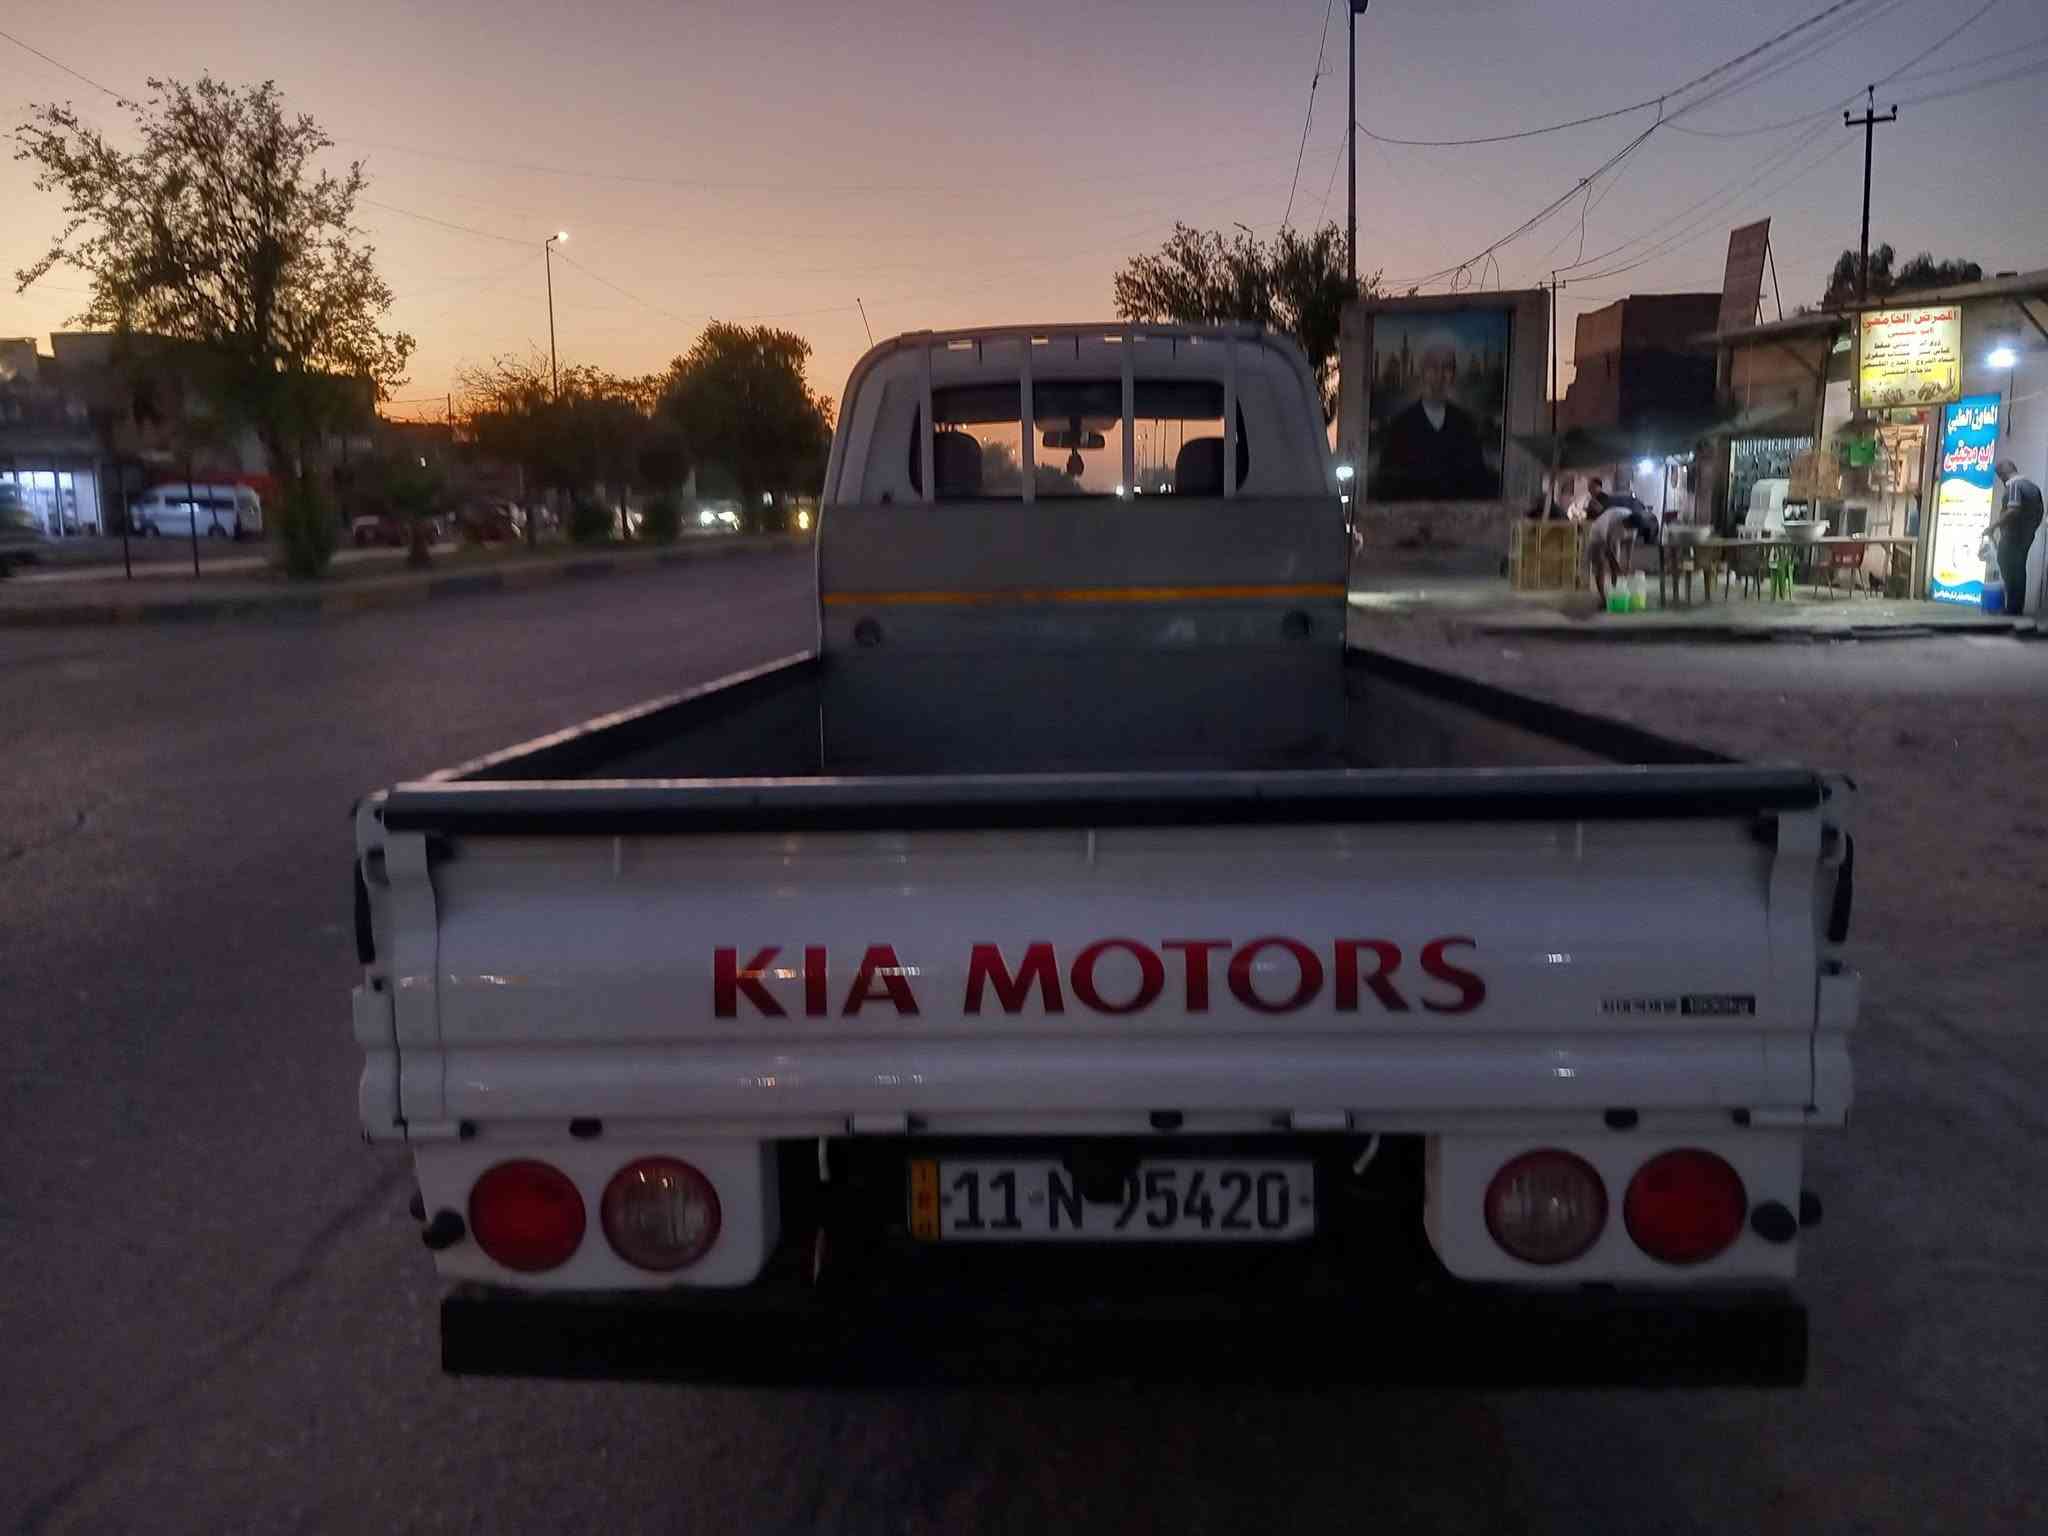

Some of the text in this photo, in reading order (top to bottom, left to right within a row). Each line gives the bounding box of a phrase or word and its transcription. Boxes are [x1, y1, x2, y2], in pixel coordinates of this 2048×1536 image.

[713, 937, 1485, 1019] KIA MOTORS
[953, 1170, 1022, 1231] 11
